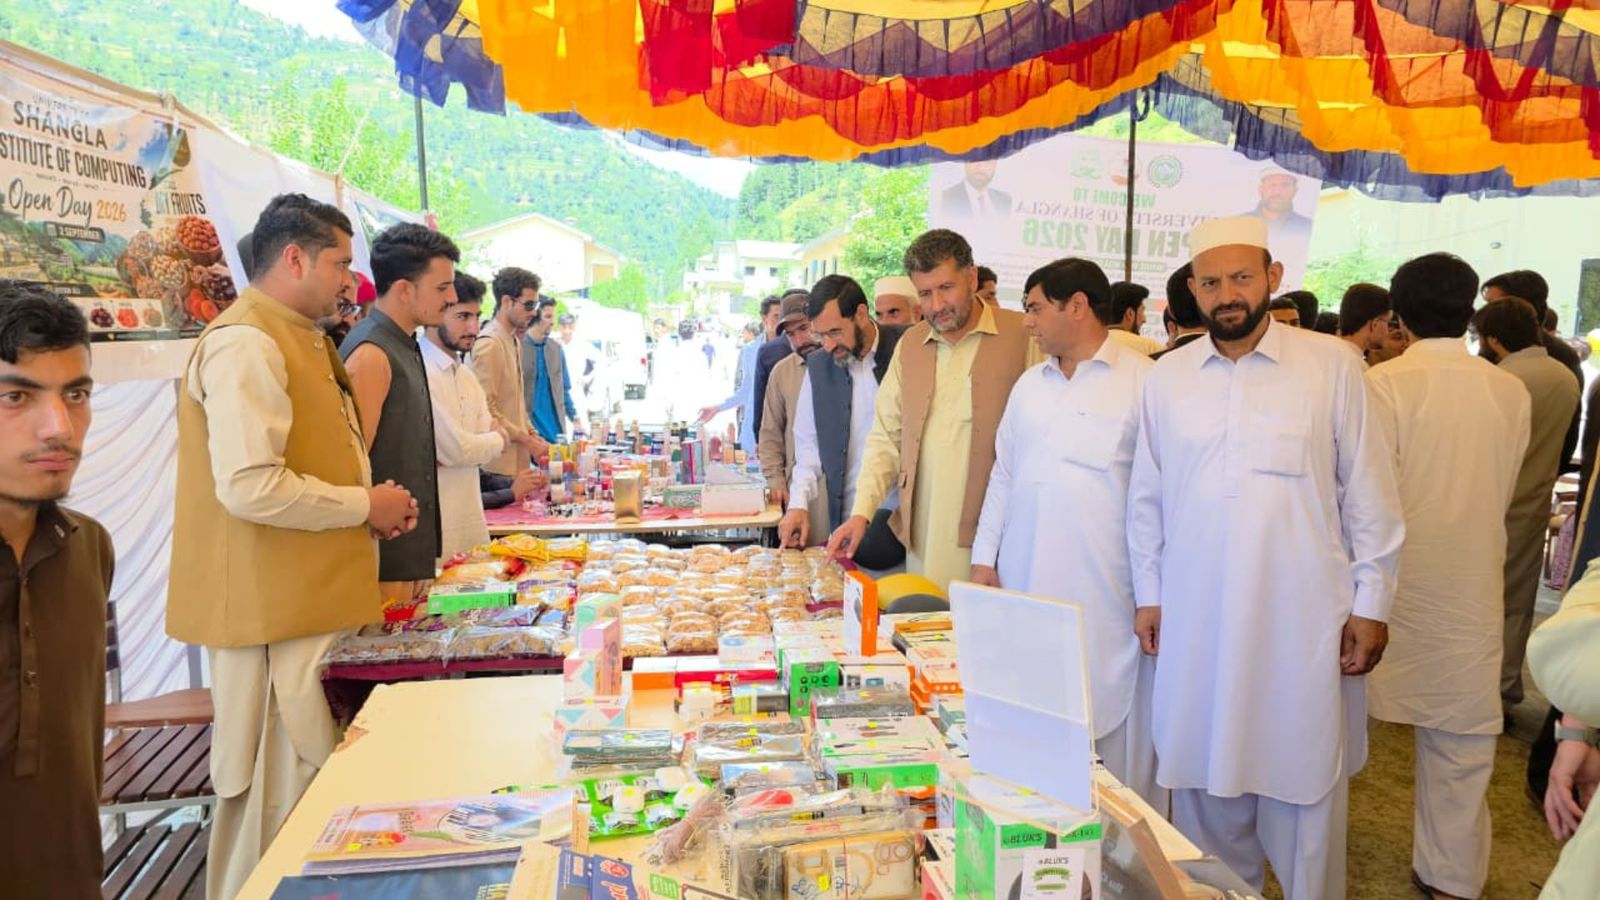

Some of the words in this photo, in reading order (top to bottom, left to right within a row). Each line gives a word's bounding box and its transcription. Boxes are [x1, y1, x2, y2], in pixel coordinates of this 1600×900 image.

[14, 100, 107, 150] SHANGLA
[56, 146, 70, 173] OF
[74, 151, 147, 188] COMPUTING
[8, 178, 52, 219] Open
[56, 186, 93, 229] Day
[96, 199, 128, 223] 2026
[171, 192, 206, 215] FRUITS
